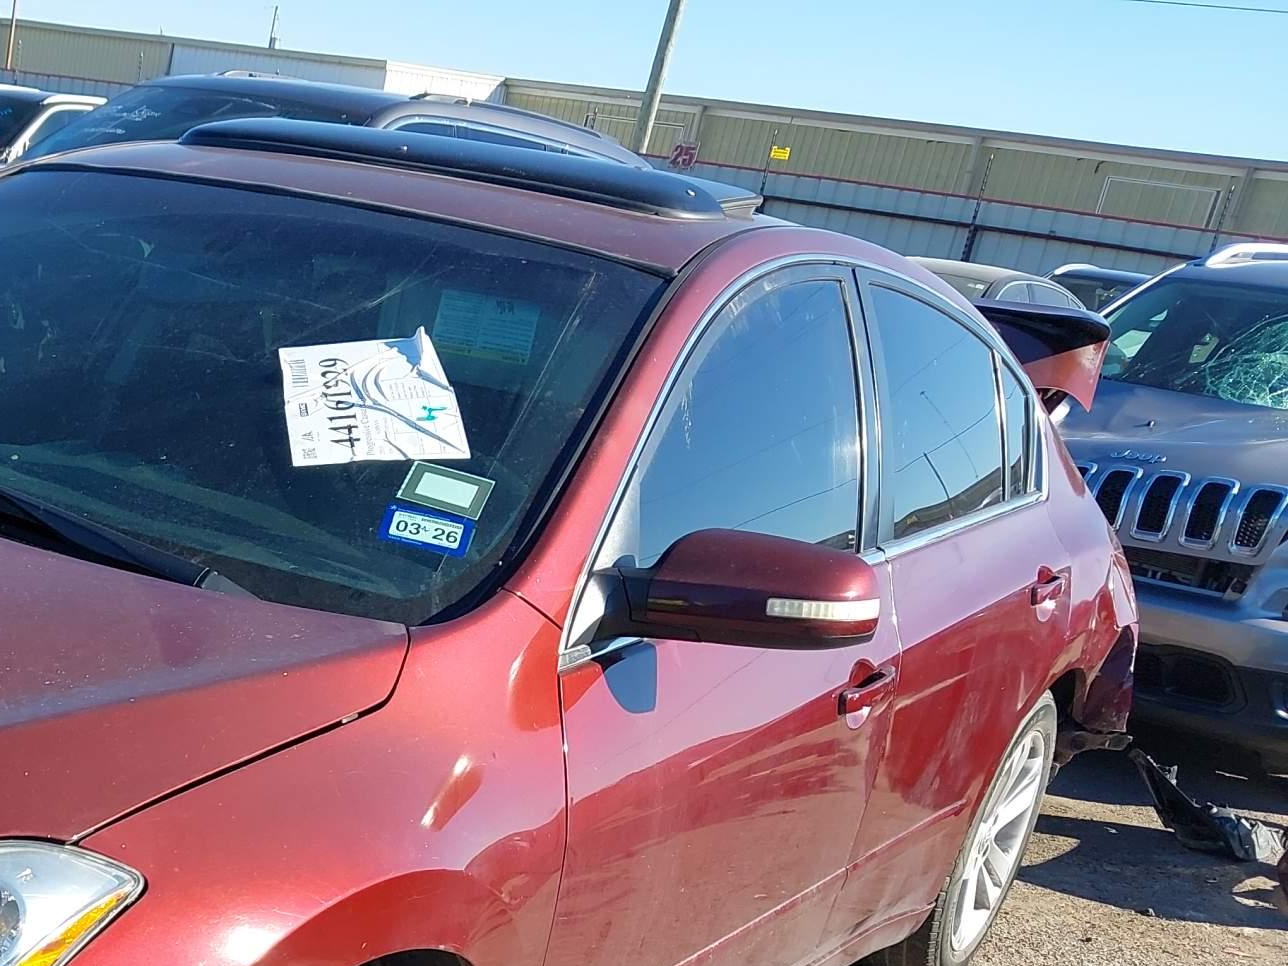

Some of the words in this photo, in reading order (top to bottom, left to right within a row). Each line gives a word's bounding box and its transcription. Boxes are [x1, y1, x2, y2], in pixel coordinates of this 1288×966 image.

[670, 143, 698, 168] 25
[1110, 449, 1168, 464] Jeep
[395, 518, 421, 536] 03
[431, 527, 458, 545] 26
